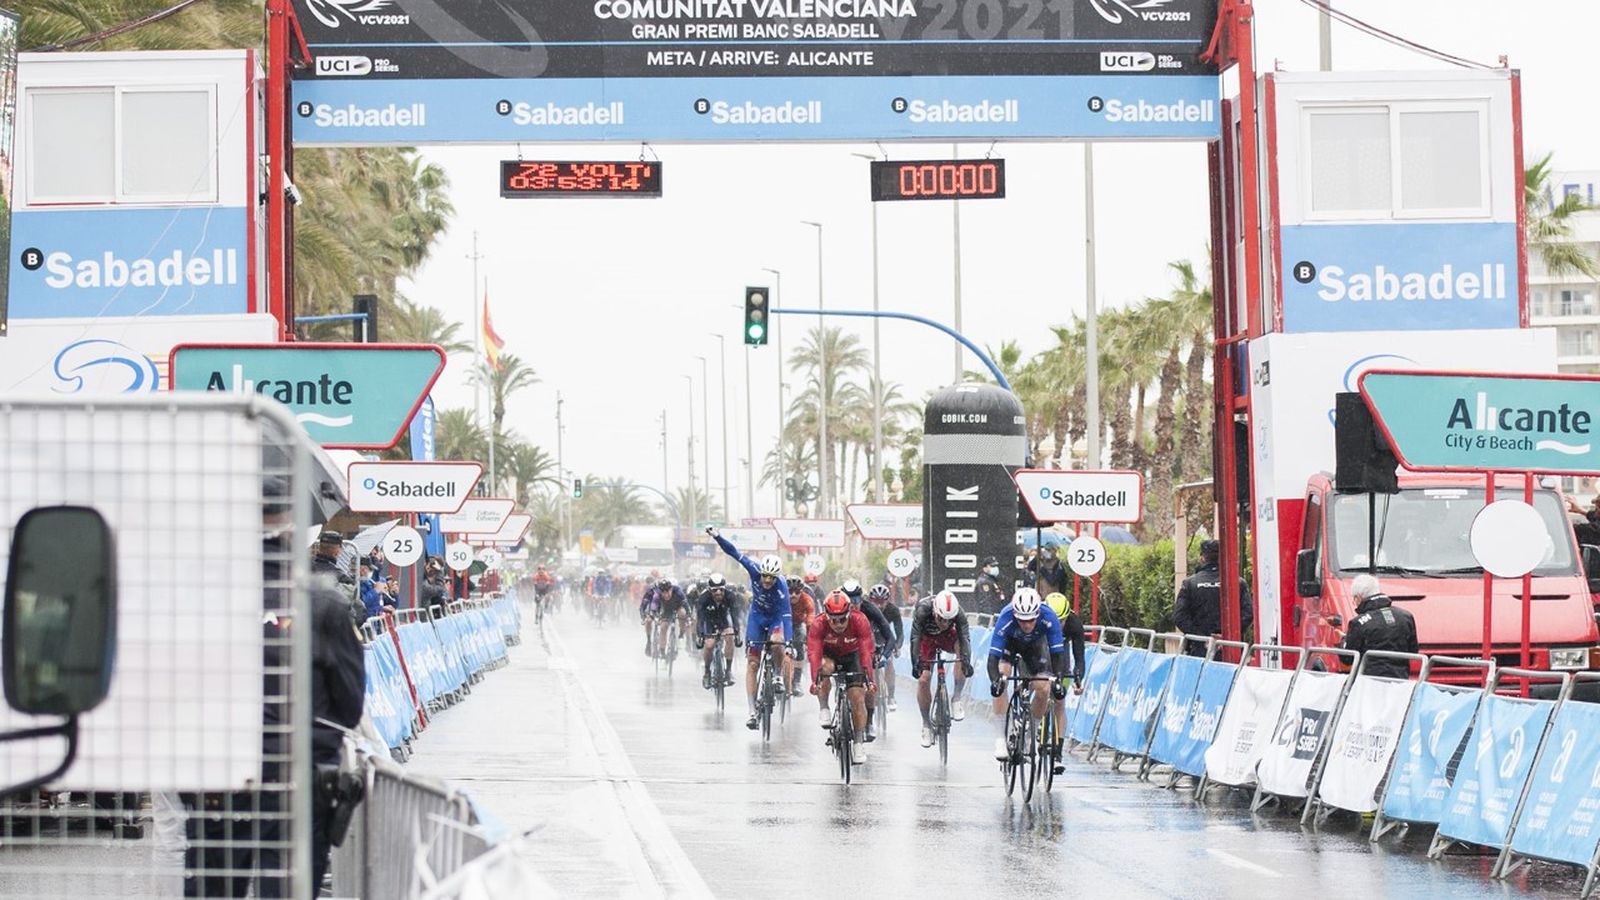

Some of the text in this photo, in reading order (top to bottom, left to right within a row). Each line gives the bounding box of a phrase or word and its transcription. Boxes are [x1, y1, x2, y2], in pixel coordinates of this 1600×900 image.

[594, 0, 917, 19] COMUNITAT VALENCIANA
[1141, 12, 1191, 22] VCV2021
[359, 15, 410, 25] VCV2021
[632, 23, 879, 39] GRAN PREMI BANC SABADELL
[320, 60, 350, 72] UCI
[647, 50, 874, 66] META / ARRIVE: ALICANTE
[1104, 55, 1134, 68] UCI
[314, 104, 425, 127] Sabadell
[513, 102, 624, 125] Sabadell
[711, 101, 822, 124] Sabadell
[909, 100, 1018, 123] Sabadell
[1104, 99, 1213, 122] Sabadell
[519, 163, 558, 177] 72
[509, 176, 641, 190] 03:53:14
[900, 165, 996, 196] 0:00:00
[45, 248, 237, 288] Sabadell
[1317, 263, 1506, 301] Sabadell
[942, 414, 987, 424] GOBIK.COM
[1446, 391, 1591, 434] Alicante
[1445, 434, 1533, 451] City & Beach
[376, 481, 455, 497] Sabadell
[1052, 490, 1126, 507] Sabadell
[393, 540, 413, 553] 25
[944, 485, 980, 593] GOBIK
[453, 552, 467, 561] 50
[894, 558, 909, 568] 50
[1077, 549, 1096, 563] 25
[809, 561, 820, 569] 75
